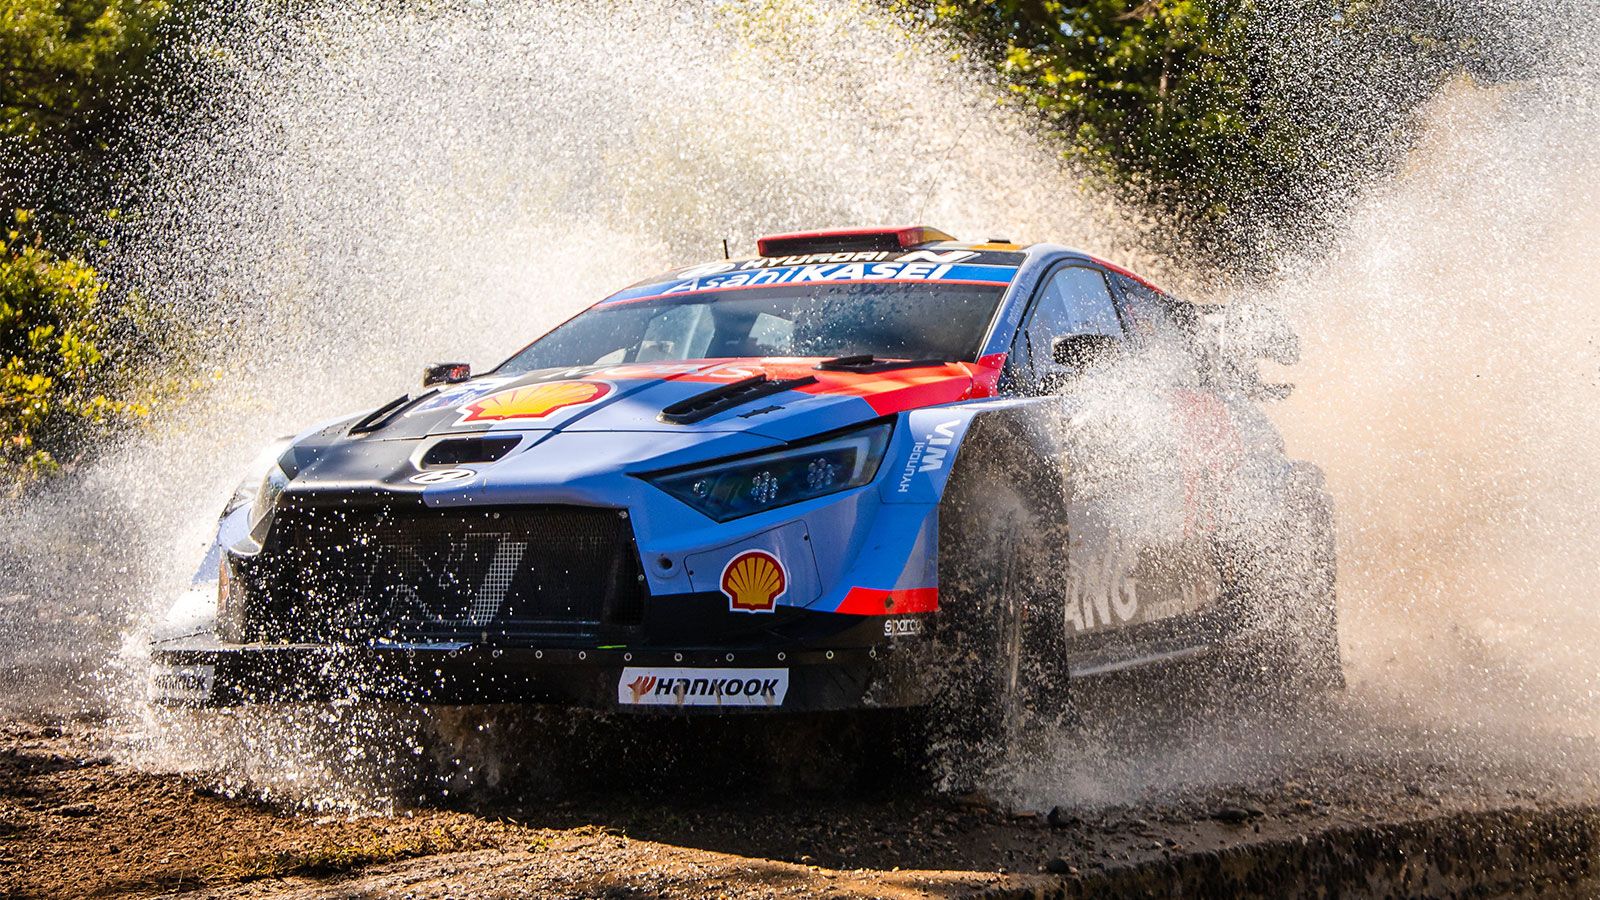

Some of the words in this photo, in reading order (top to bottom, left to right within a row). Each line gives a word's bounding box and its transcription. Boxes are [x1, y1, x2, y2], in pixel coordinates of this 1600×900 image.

[740, 251, 889, 270] HYUNDAI
[897, 442, 925, 493] HYUNDAI
[884, 619, 921, 638] sparco
